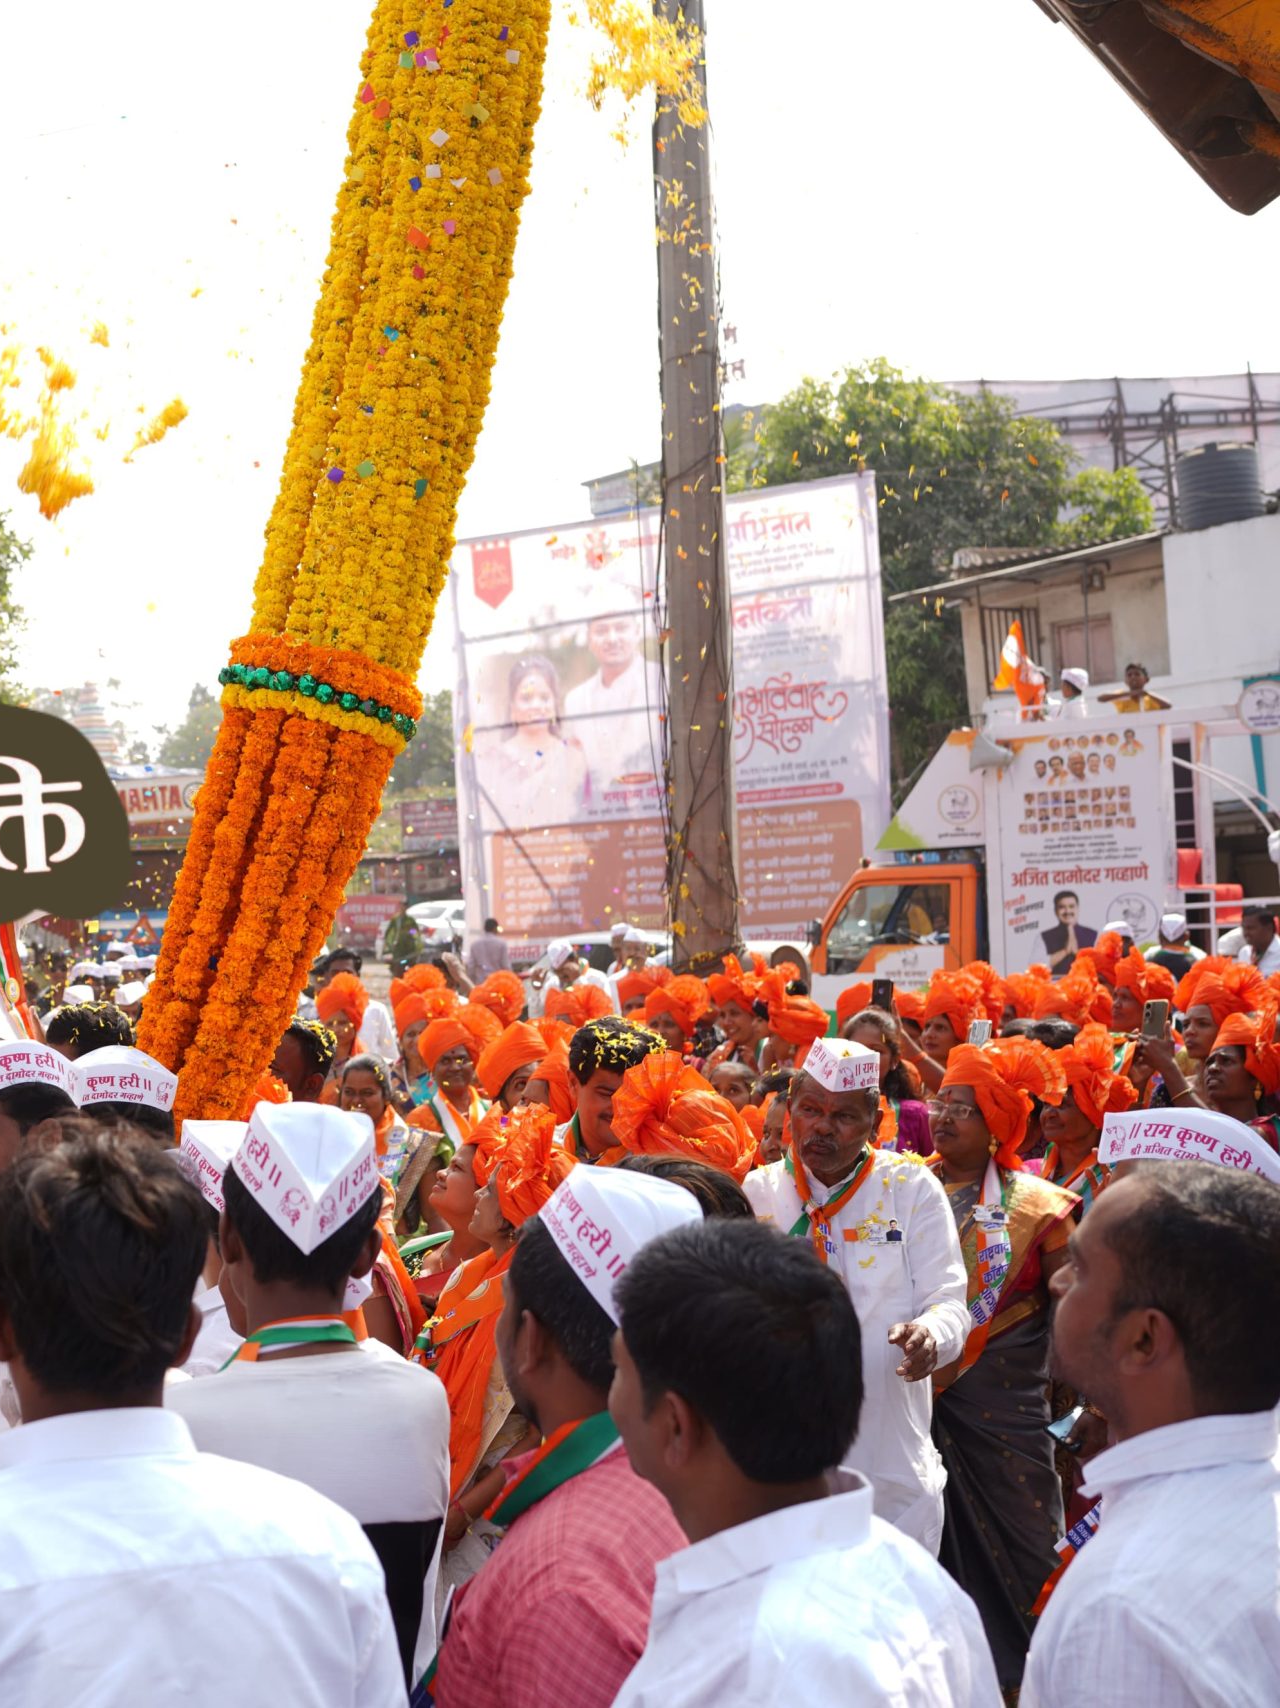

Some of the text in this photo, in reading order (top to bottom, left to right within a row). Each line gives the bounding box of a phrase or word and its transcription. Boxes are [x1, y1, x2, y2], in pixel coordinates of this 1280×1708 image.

[1011, 861, 1149, 887] अजित दामोदर गव्हाणे
[0, 1052, 31, 1071] कृष्ण
[34, 1052, 55, 1069] हरी
[5, 1068, 36, 1082] दामोदर
[86, 1075, 115, 1091] कृष्ण
[119, 1073, 140, 1089] हरी
[91, 1090, 118, 1100] दामोदर
[247, 1138, 270, 1169] हरी
[1131, 1143, 1204, 1160] श्री अजित दामो
[1144, 1123, 1175, 1139] राम
[1176, 1126, 1220, 1153] कृष्ण
[1220, 1144, 1254, 1170] हरी
[198, 1158, 221, 1185] कृष्ण
[352, 1156, 370, 1185] राम
[577, 1217, 612, 1257] हरी
[979, 1243, 1009, 1263] राष्ट्रवाद
